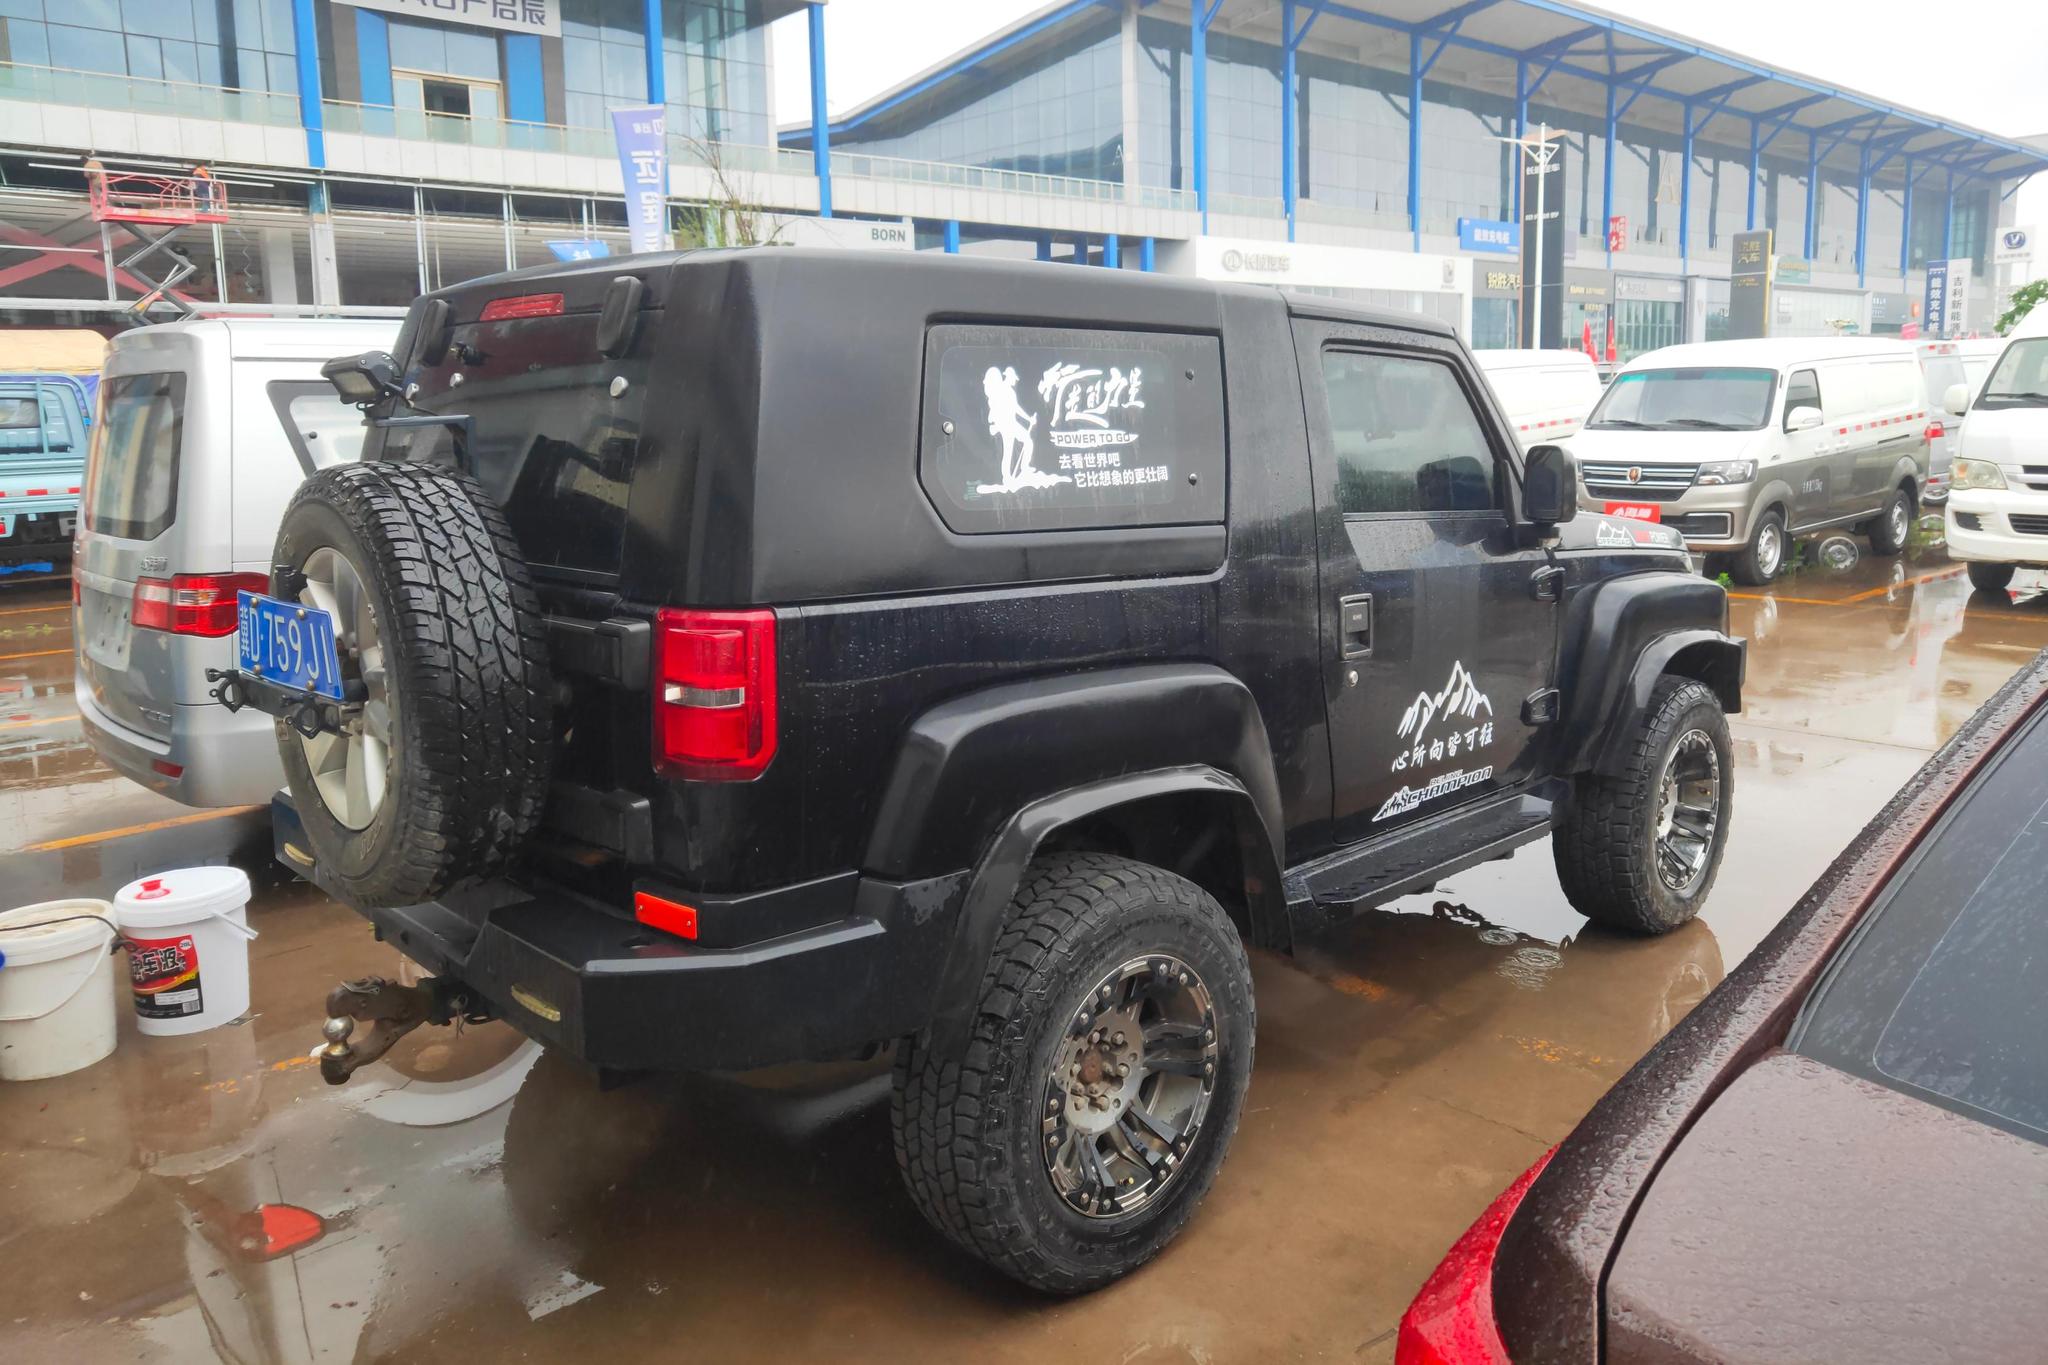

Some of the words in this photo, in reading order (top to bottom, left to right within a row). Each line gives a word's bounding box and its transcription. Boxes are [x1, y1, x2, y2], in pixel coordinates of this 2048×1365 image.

[871, 228, 906, 242] BORN
[1056, 433, 1097, 445] POWER
[1100, 433, 1114, 444] TO
[1116, 431, 1132, 443] GO
[1058, 451, 1121, 471] 去看世界吧
[1073, 464, 1170, 489] 它比想象的更壮阔
[1408, 766, 1493, 805] CHAMPION
